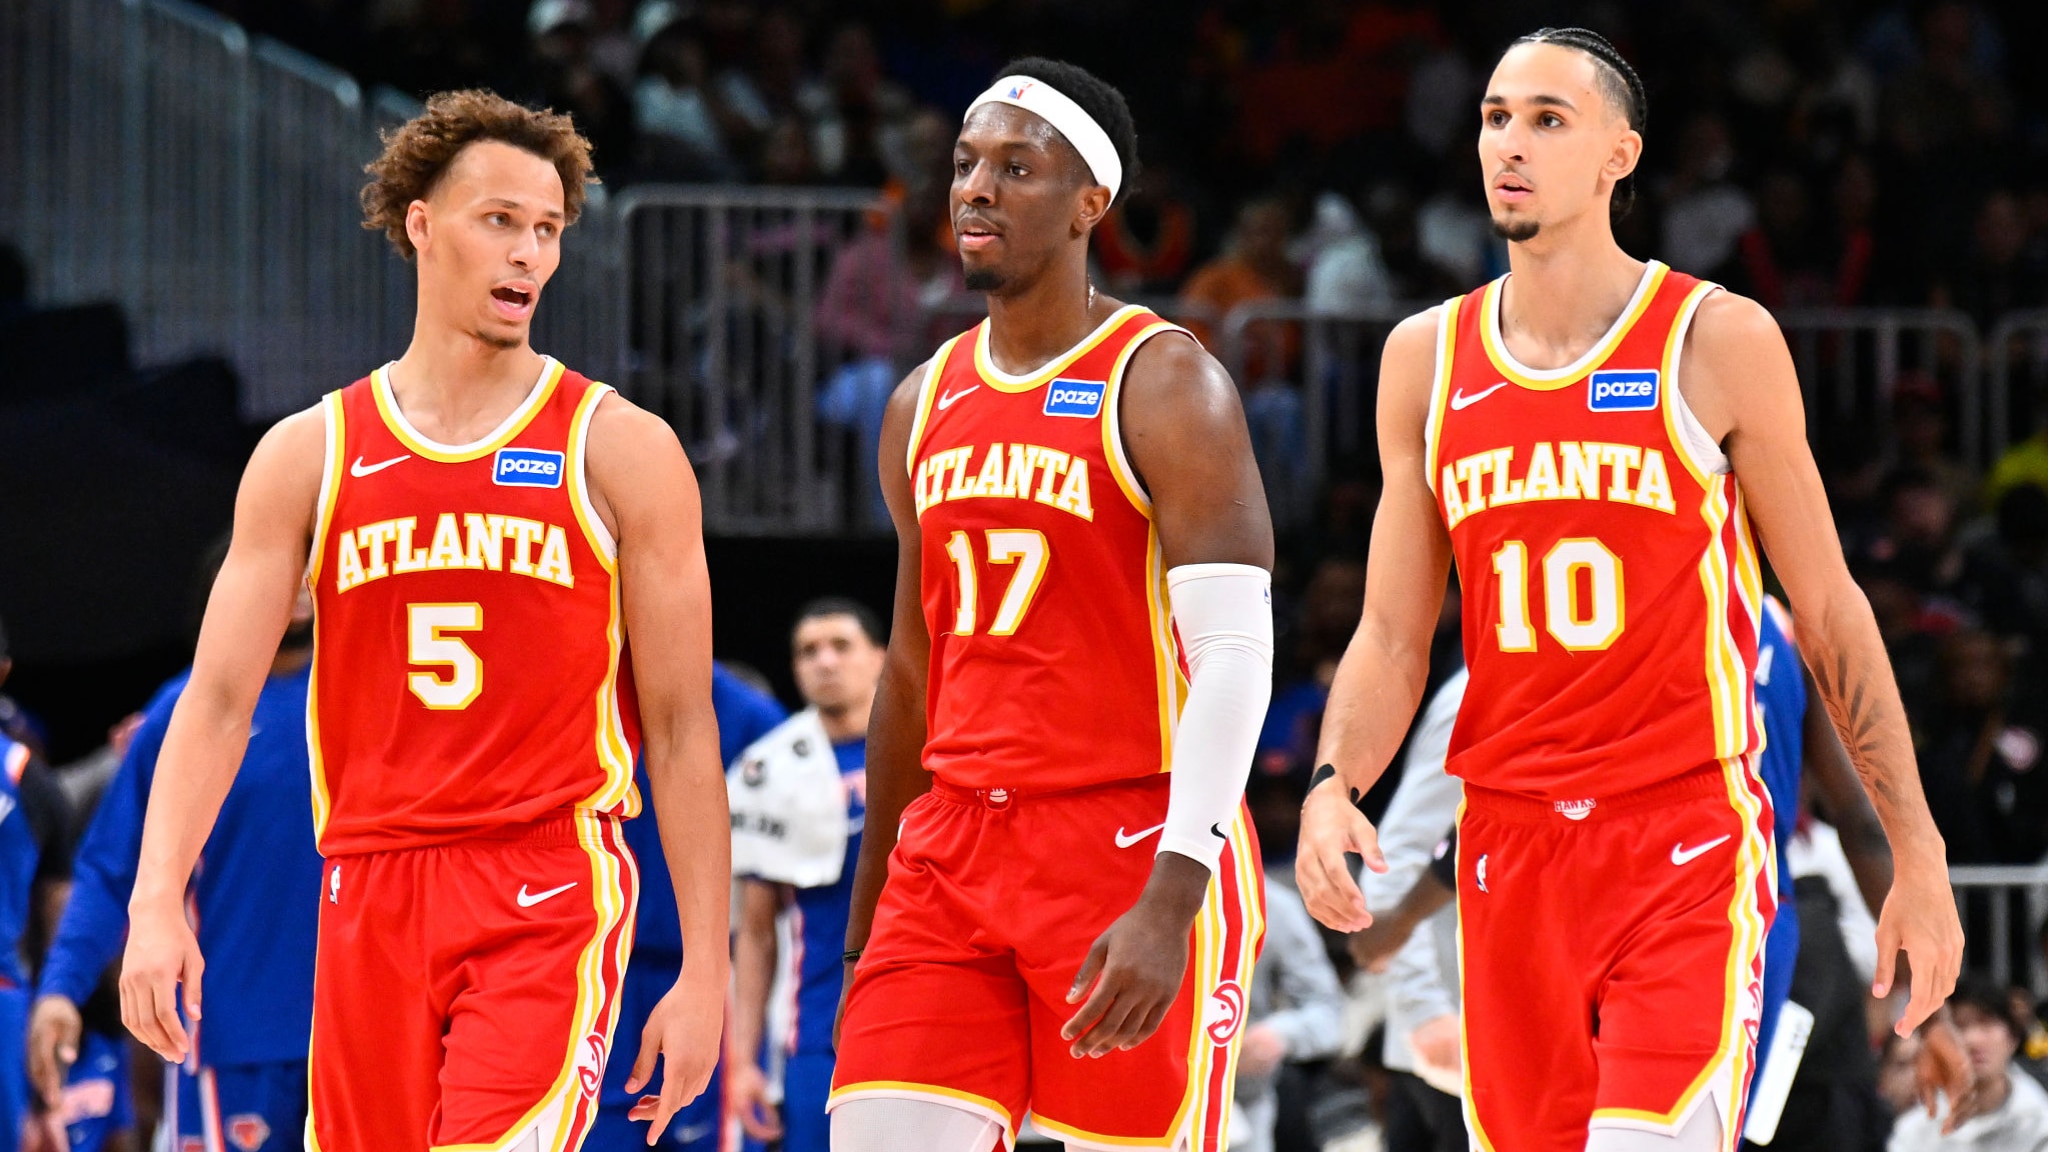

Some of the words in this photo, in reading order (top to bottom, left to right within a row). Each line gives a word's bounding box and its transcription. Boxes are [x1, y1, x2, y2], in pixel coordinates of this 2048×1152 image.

[1051, 389, 1099, 406] paze
[1595, 381, 1653, 401] paze
[500, 458, 557, 476] paze
[915, 442, 1094, 521] ATLANTA
[1442, 441, 1676, 530] ATLANTA
[337, 512, 574, 594] ATLANTA
[945, 528, 1050, 636] 17
[1492, 538, 1625, 653] 10
[407, 602, 483, 710] 5
[1554, 798, 1597, 812] HAWKS
